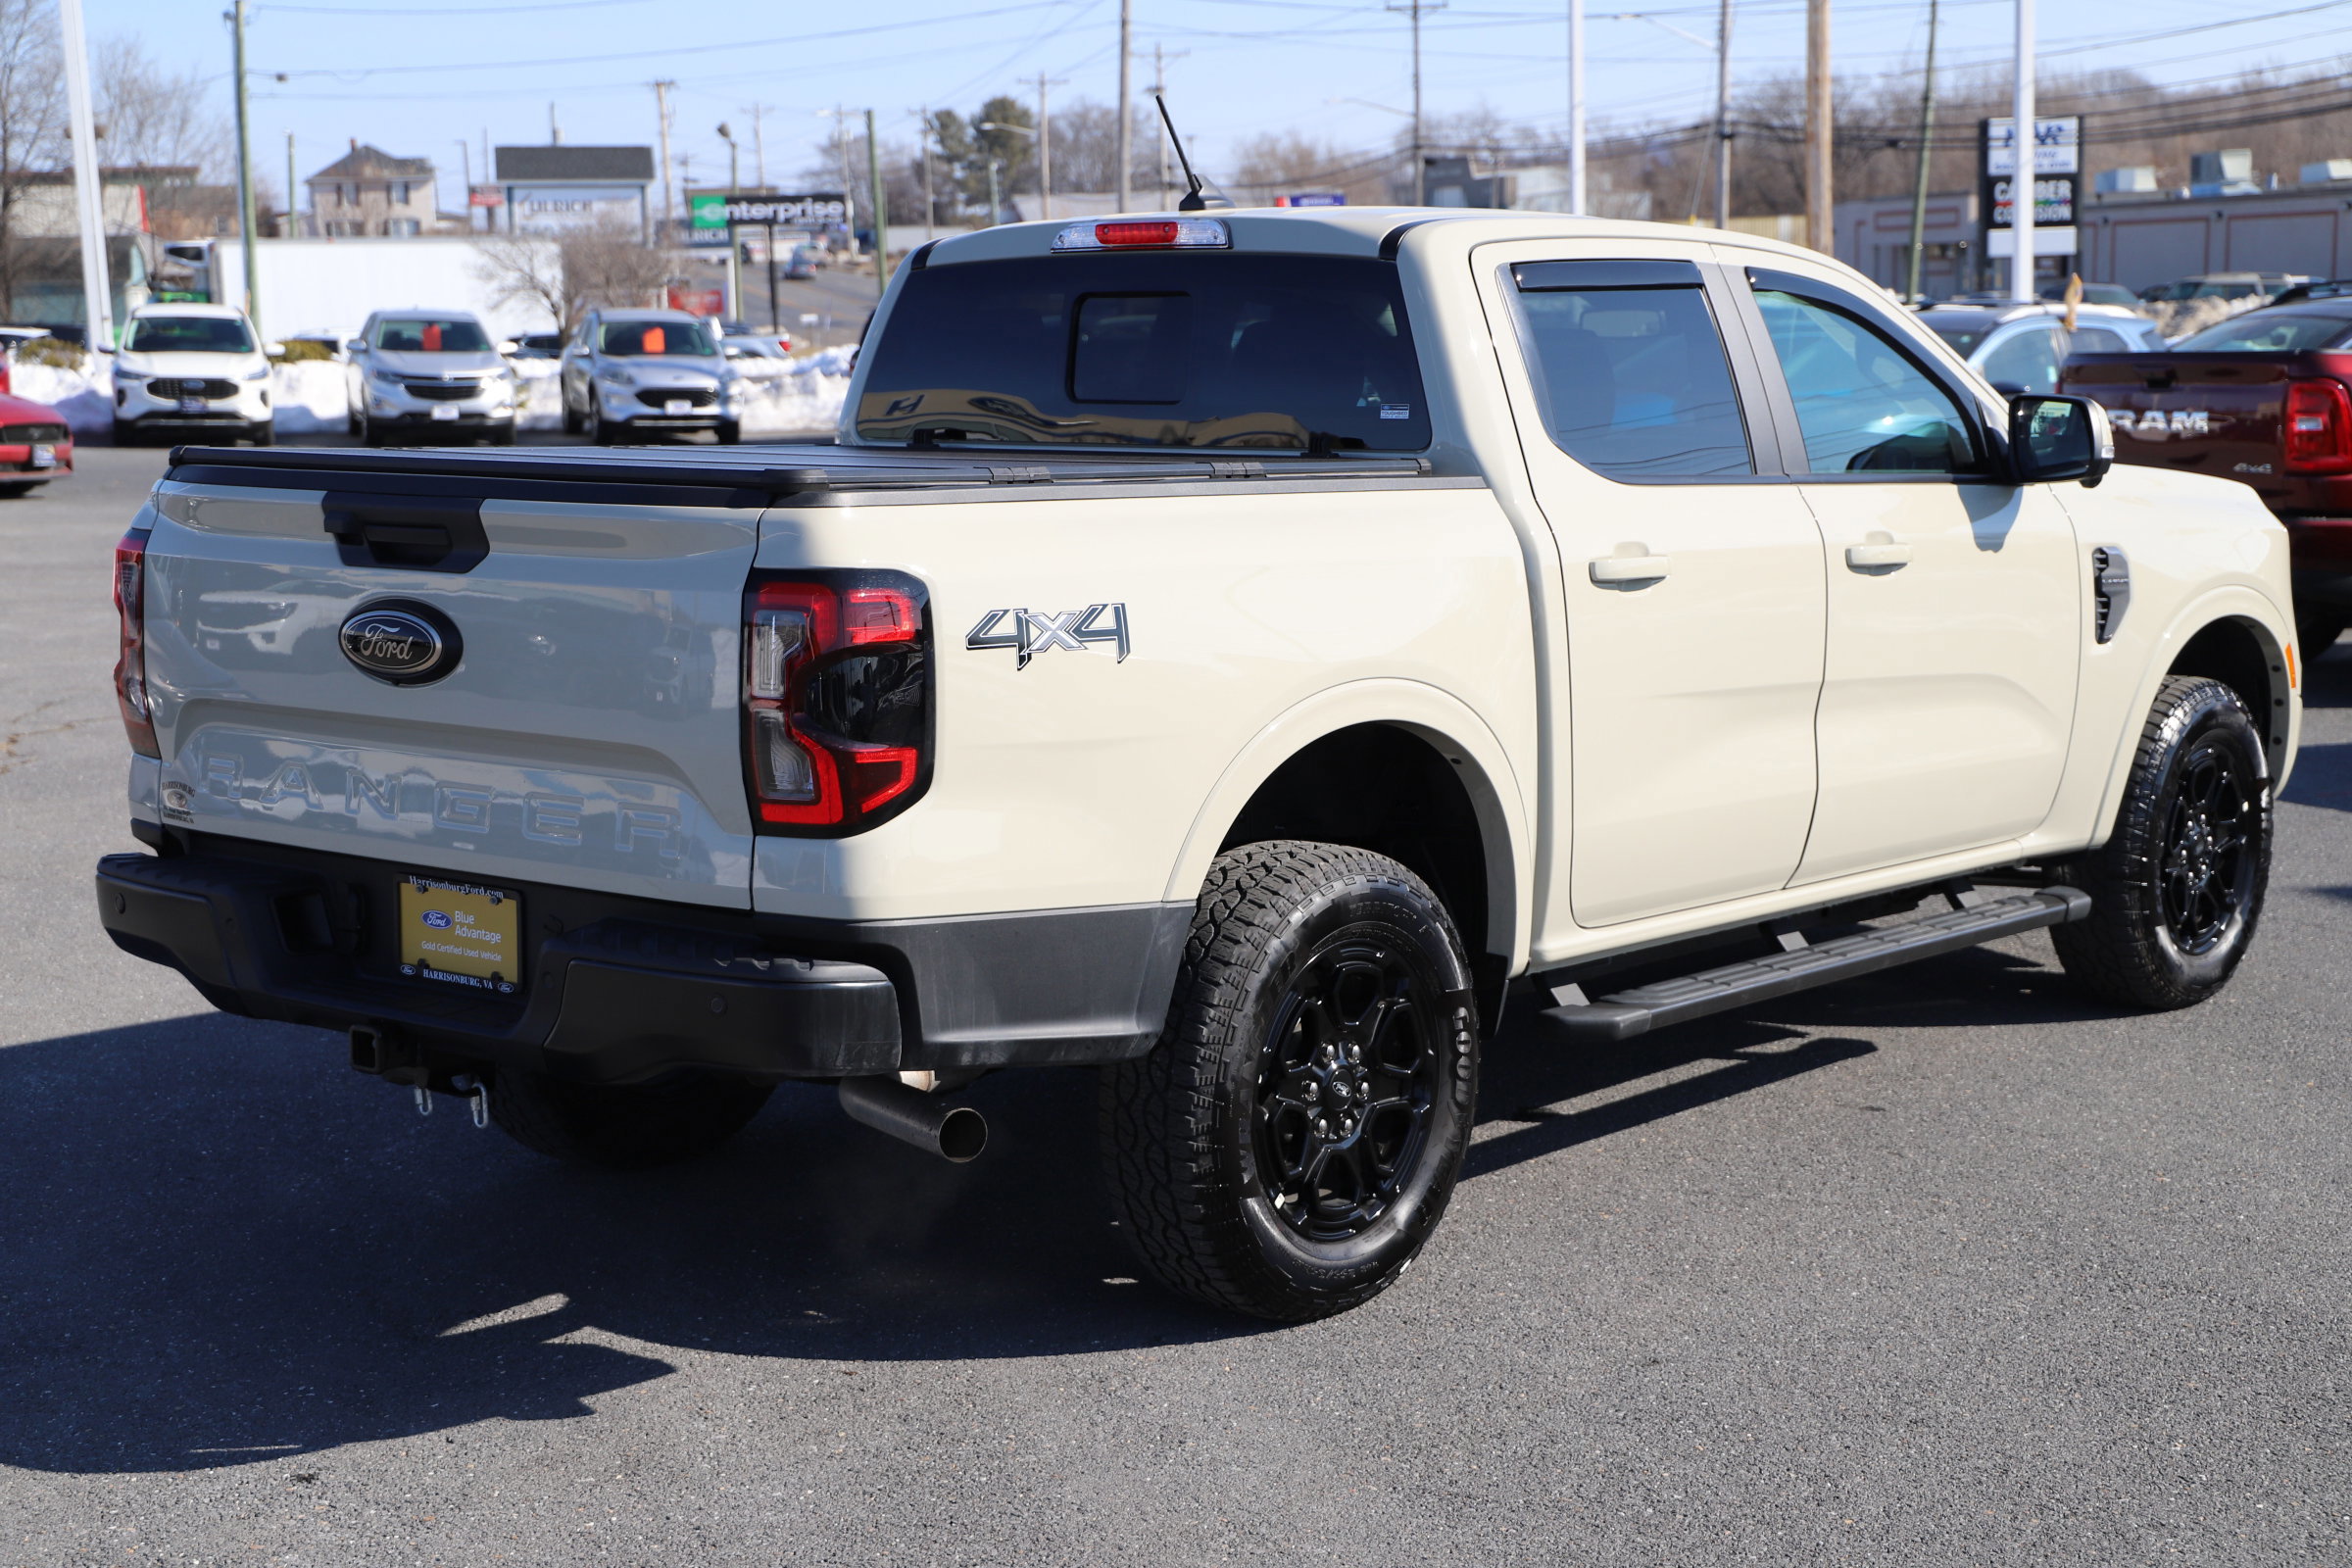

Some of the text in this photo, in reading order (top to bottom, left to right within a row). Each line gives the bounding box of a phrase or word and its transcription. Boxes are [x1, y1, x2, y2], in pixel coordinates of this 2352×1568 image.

[694, 197, 845, 222] enterprise
[2107, 410, 2209, 434] RAM
[360, 622, 414, 660] Ford
[200, 753, 682, 858] RANGER
[409, 875, 504, 899] HarrisonburgFord.com
[426, 910, 447, 927] Ford
[455, 910, 475, 924] Blue
[455, 925, 502, 944] Advantage
[421, 941, 502, 961] Gold Certified Used Vehicle
[422, 968, 493, 990] HARRISONBURG, VA
